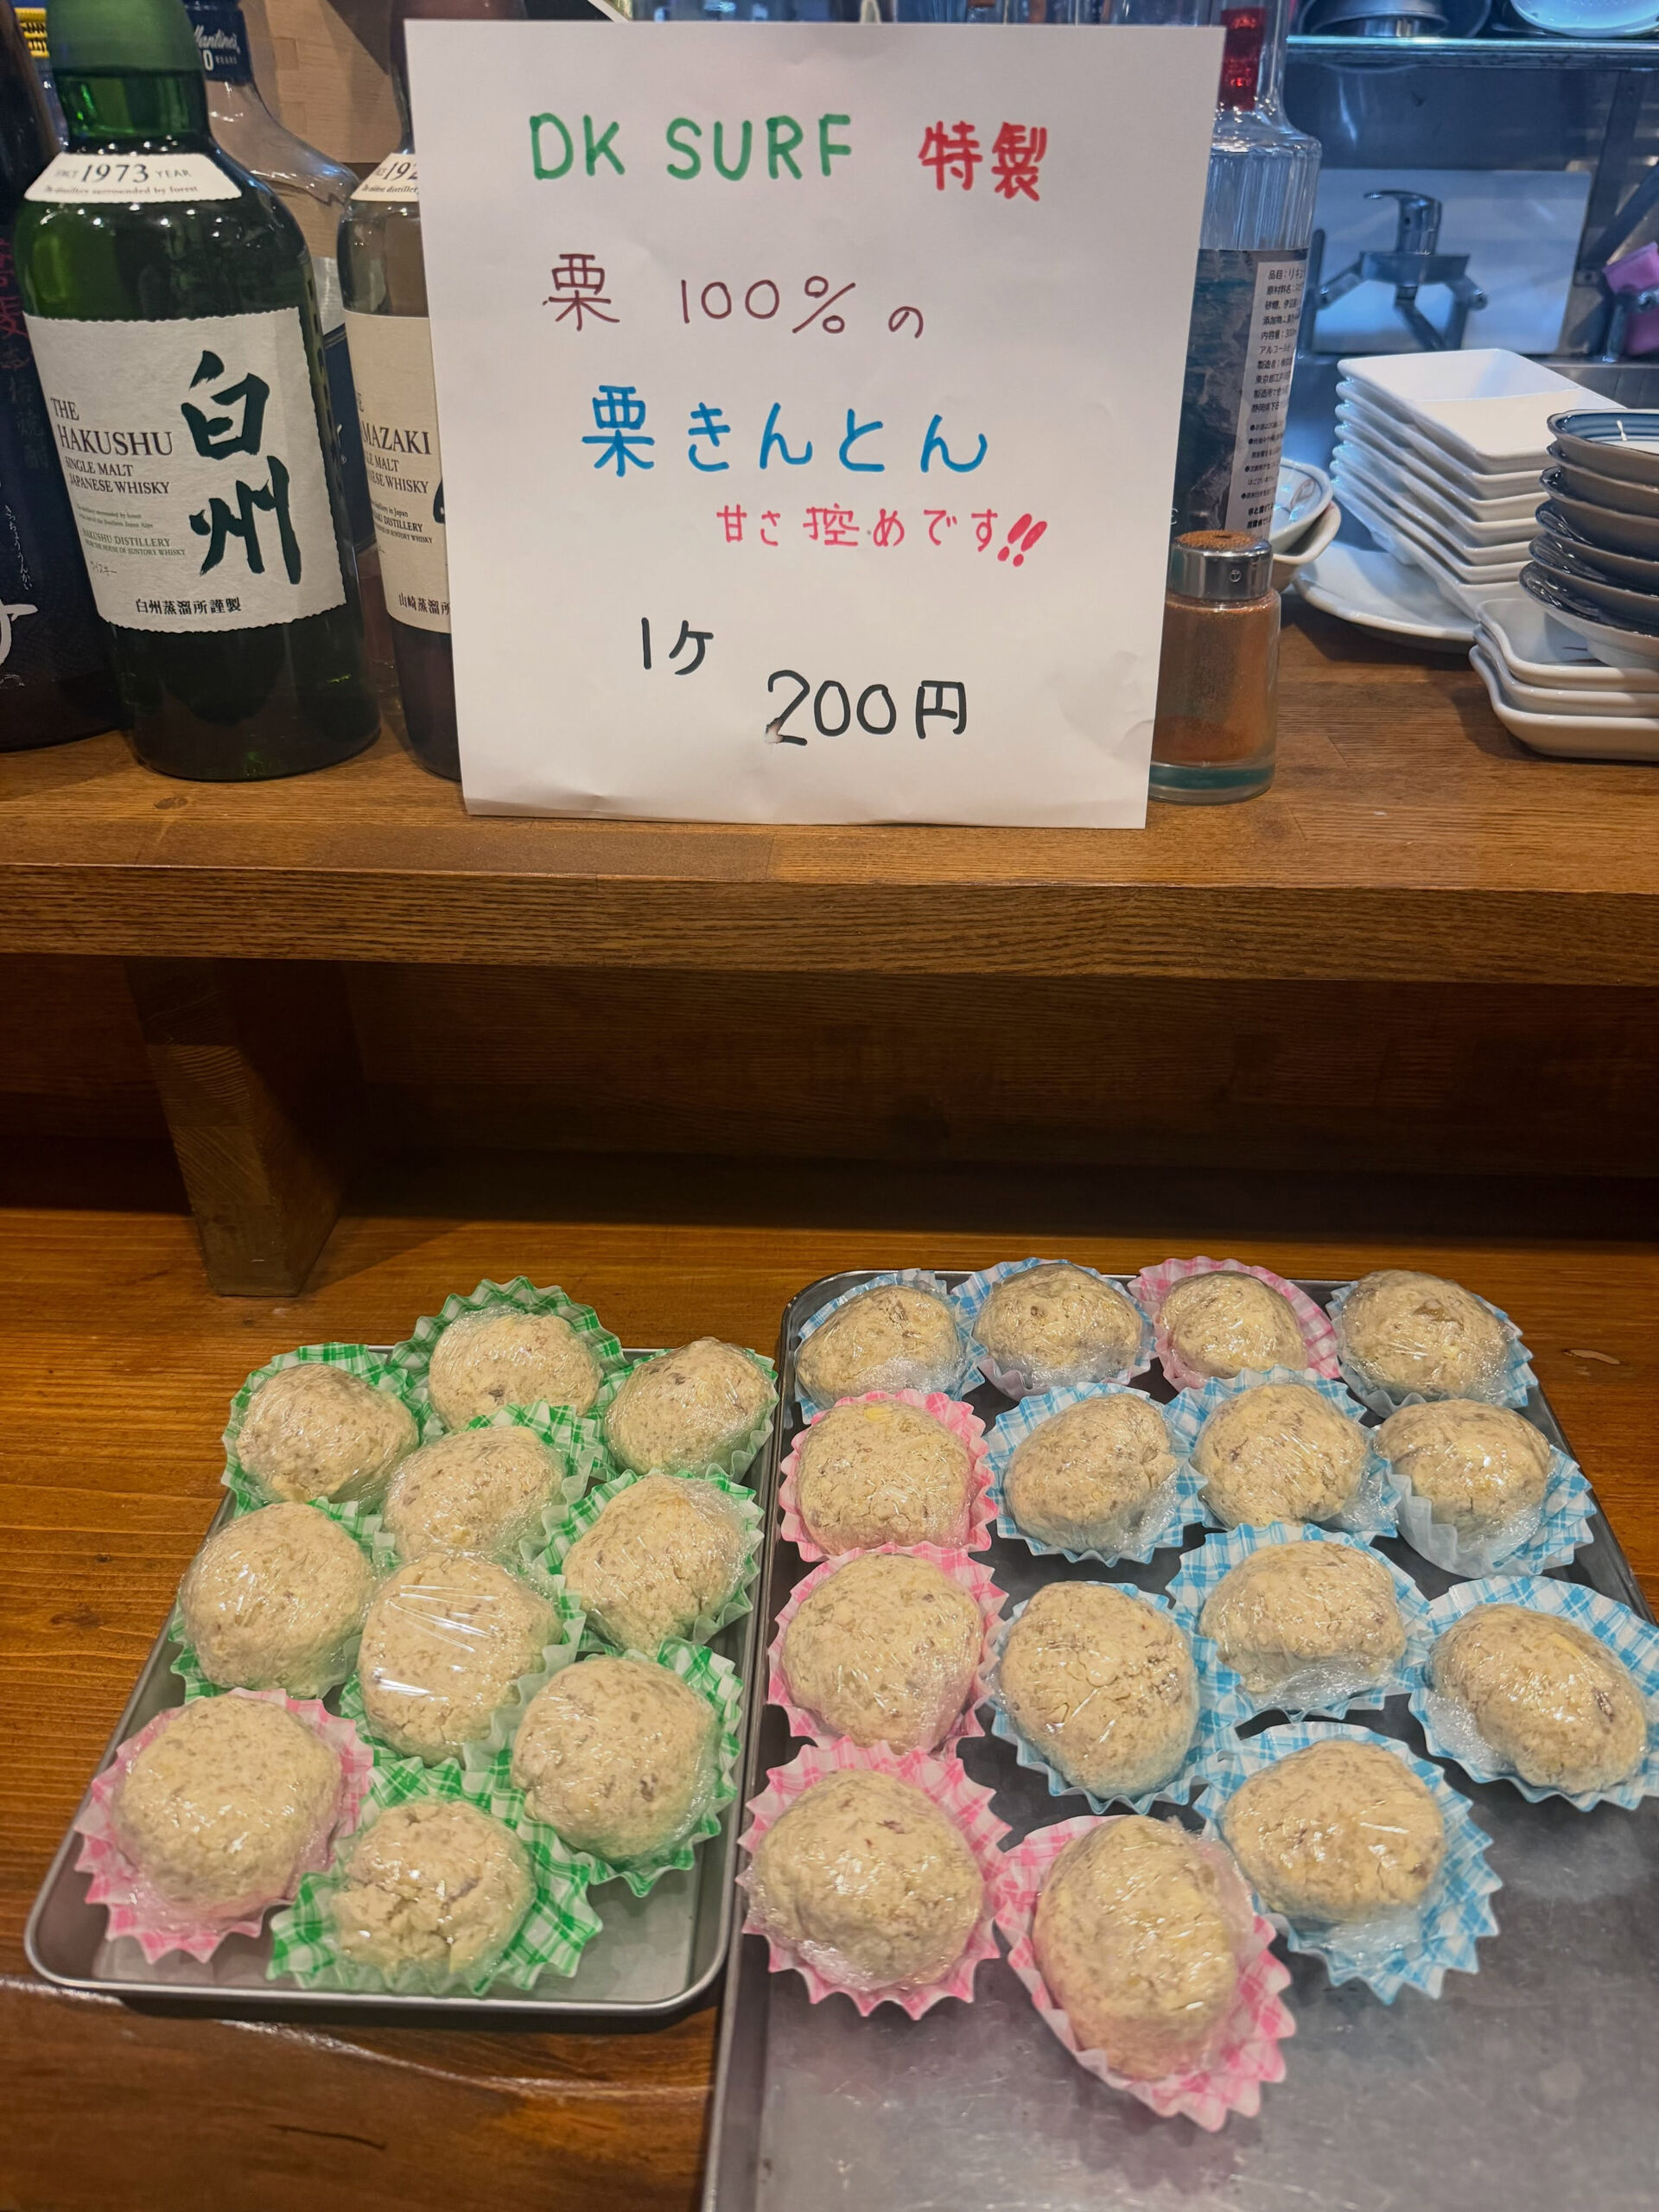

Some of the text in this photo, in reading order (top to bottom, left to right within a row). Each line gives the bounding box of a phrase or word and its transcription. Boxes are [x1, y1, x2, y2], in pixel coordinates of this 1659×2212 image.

[529, 112, 1048, 201] DK SURF 特製
[80, 163, 149, 183] 1973
[156, 169, 192, 178] YEAR
[153, 186, 167, 196] by
[169, 185, 199, 194] forest
[543, 253, 620, 331] 栗
[50, 397, 79, 422] THE
[57, 423, 173, 455] HAKUSHU
[581, 385, 988, 477] 栗きんとん
[65, 455, 133, 477] SINGLE MALT
[181, 349, 302, 585] 白州
[374, 454, 399, 473] MALT
[69, 473, 170, 494] JAPANESE WHISKY
[385, 475, 429, 494] WHISKY
[394, 507, 409, 518] Japan
[383, 516, 423, 533] DISTILLERY
[115, 536, 171, 548] DISTILLERY
[411, 534, 433, 544] WHISKY
[128, 547, 157, 556] SUNTORY
[135, 596, 242, 615] 白州蒸溜所謹製
[764, 669, 968, 747] 200円
